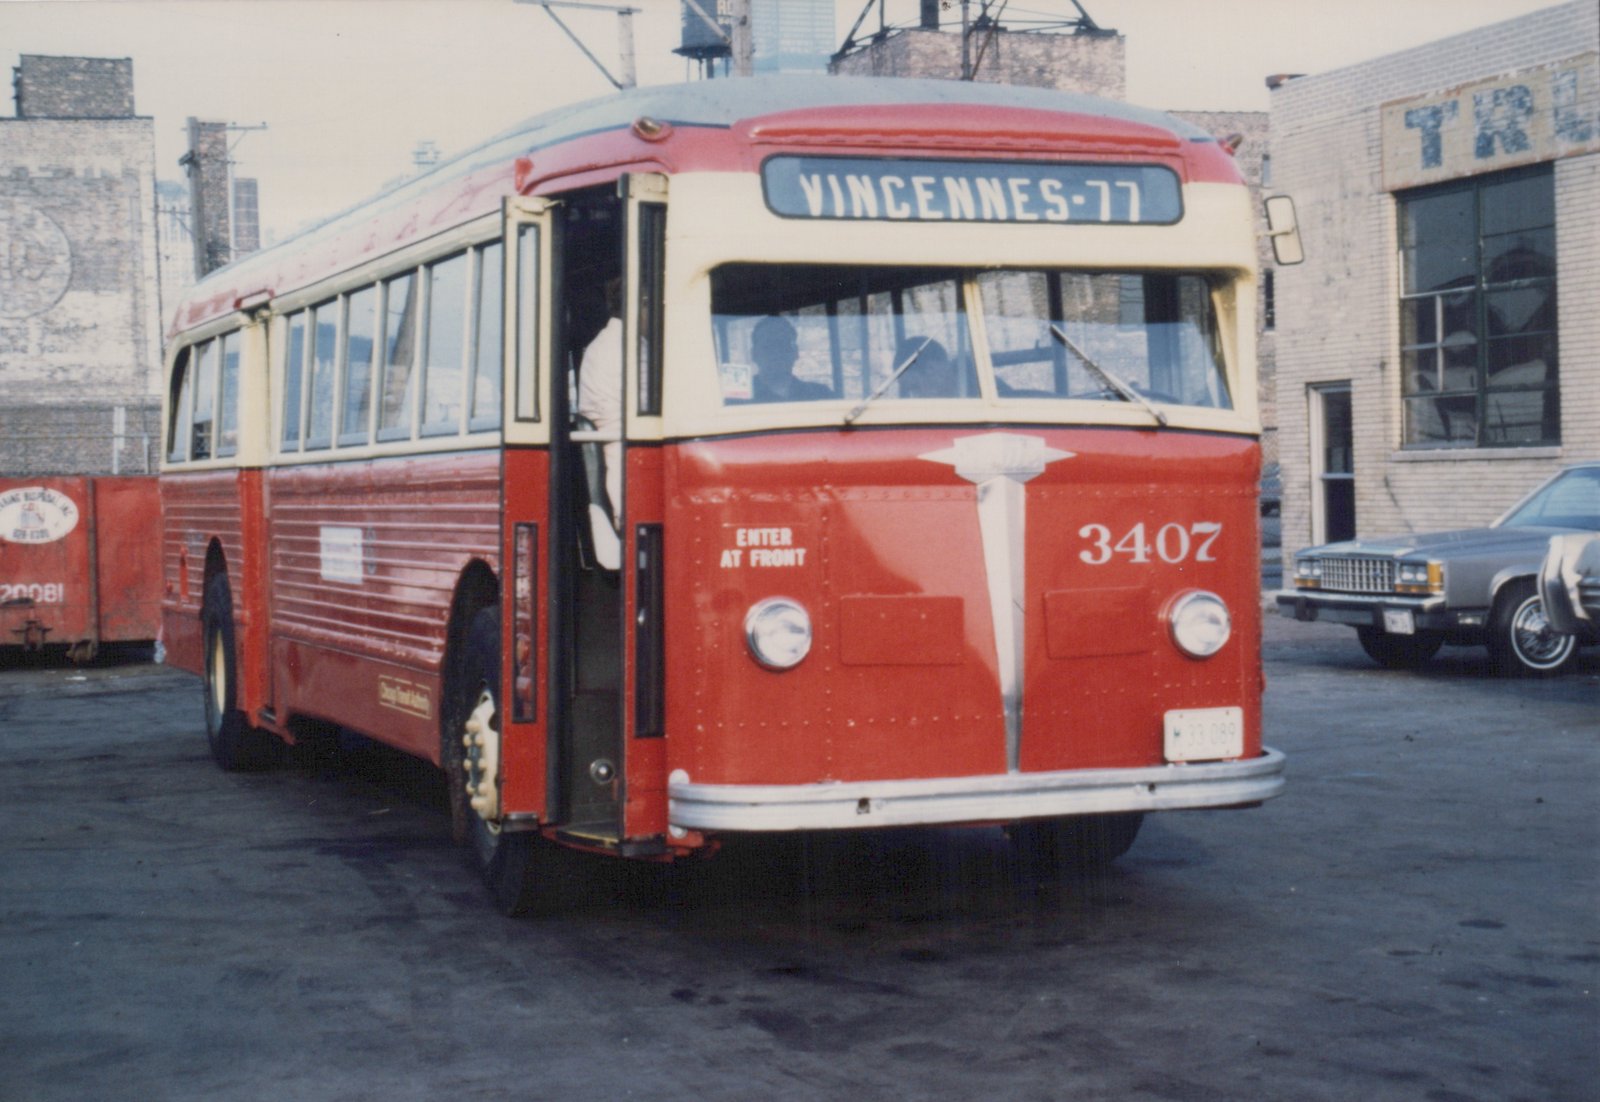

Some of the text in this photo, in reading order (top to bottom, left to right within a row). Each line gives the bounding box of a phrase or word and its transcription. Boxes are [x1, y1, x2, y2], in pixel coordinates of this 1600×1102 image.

[800, 173, 1141, 223] VINCENNES-77
[736, 527, 792, 546] ENTER
[1078, 522, 1222, 564] 3407
[720, 547, 806, 568] AT FRONT
